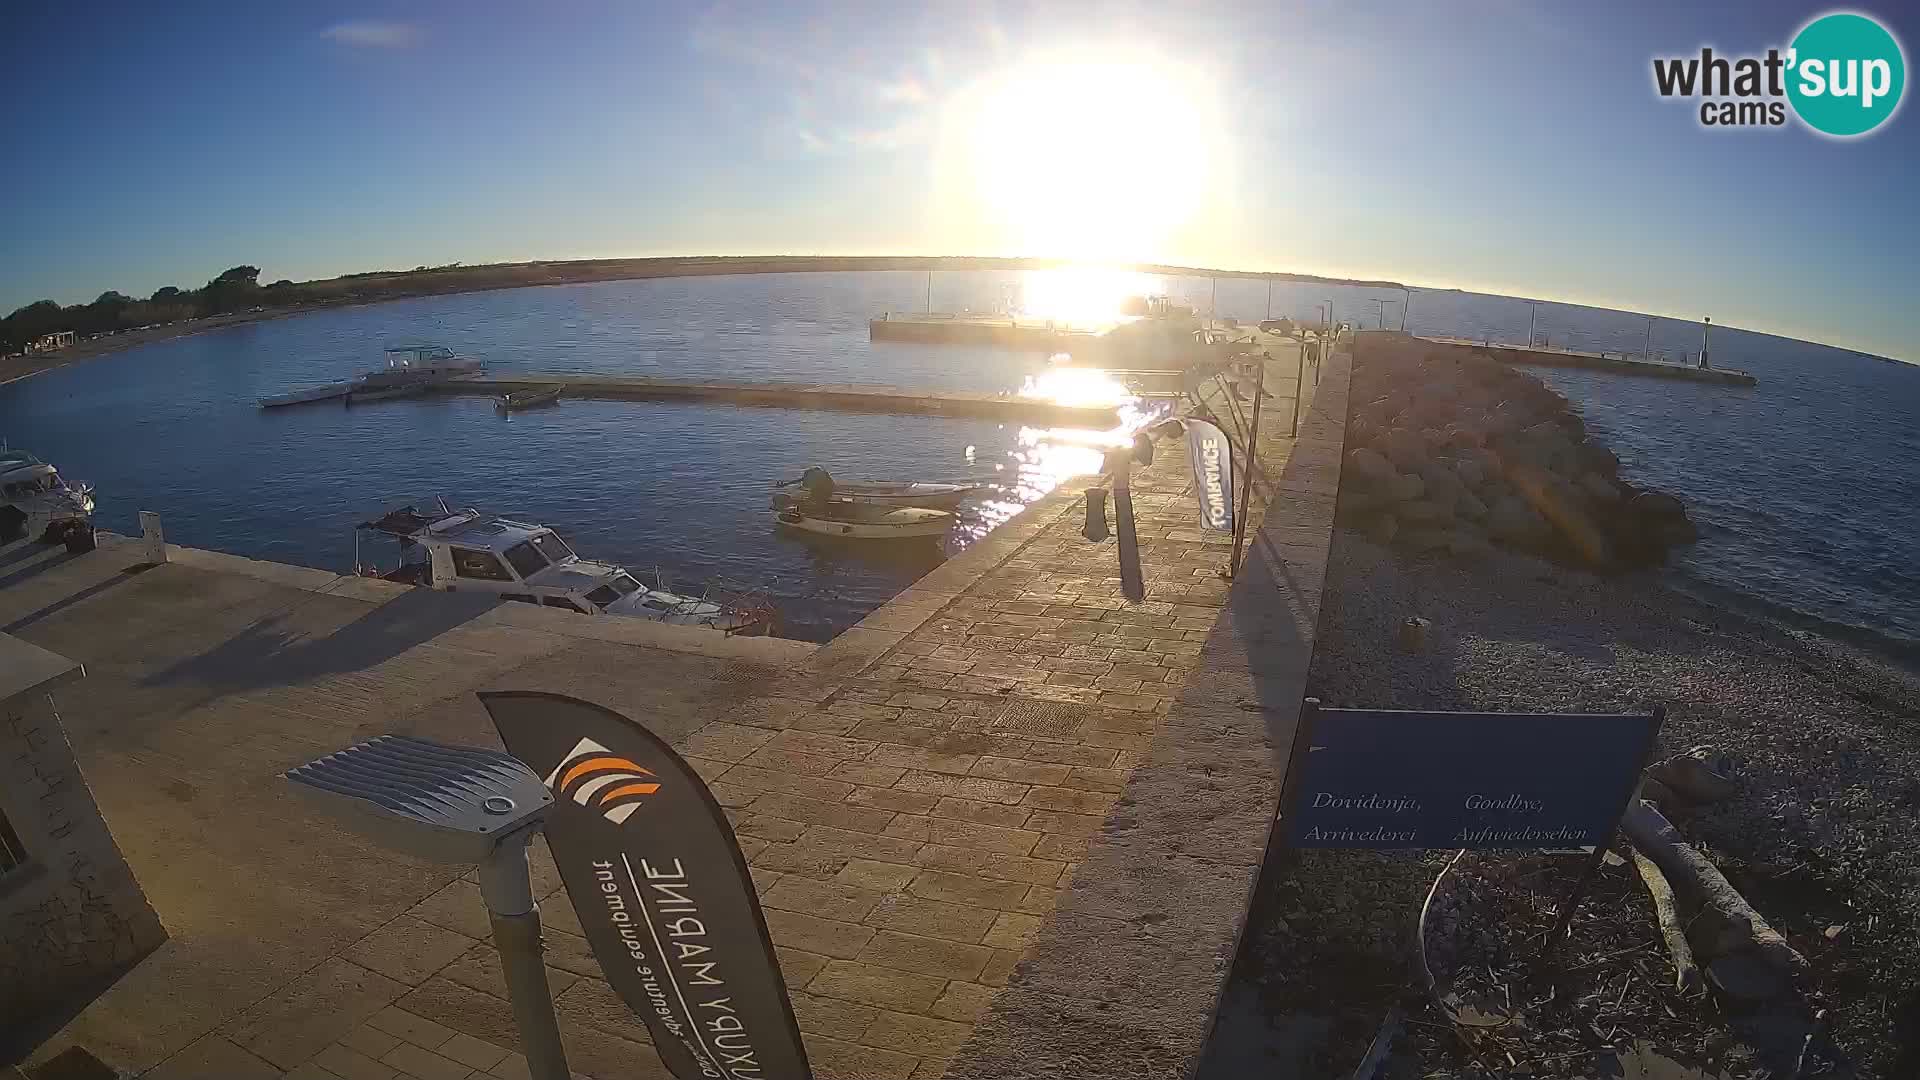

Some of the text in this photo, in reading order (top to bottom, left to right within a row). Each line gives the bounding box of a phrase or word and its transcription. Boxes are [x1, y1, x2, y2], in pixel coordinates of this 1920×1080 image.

[1311, 792, 1423, 815] Dovidenja,
[1465, 793, 1544, 814] Goodbye,
[1303, 826, 1417, 841] Arrivederci
